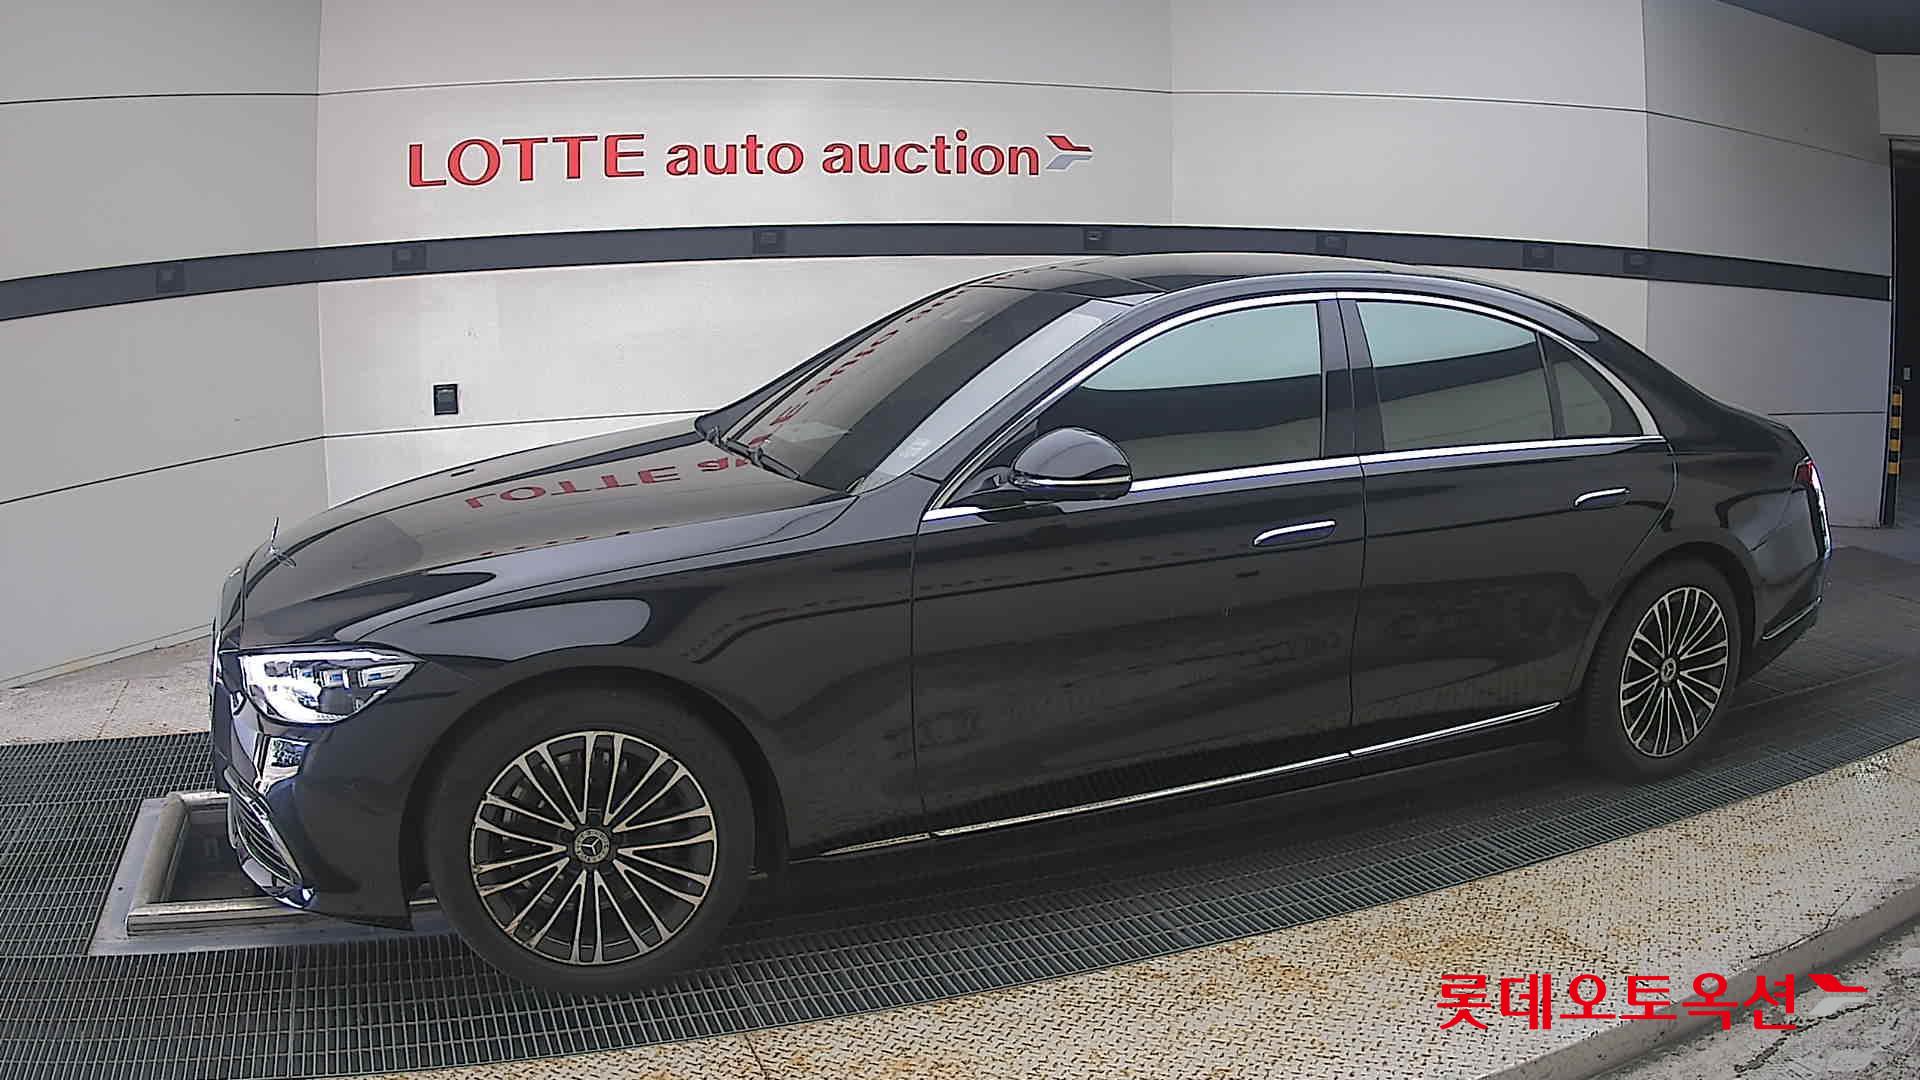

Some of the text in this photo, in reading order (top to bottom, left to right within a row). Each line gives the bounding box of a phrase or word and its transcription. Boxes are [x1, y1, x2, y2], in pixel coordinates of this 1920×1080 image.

[408, 128, 1040, 189] LOTTE auto auction
